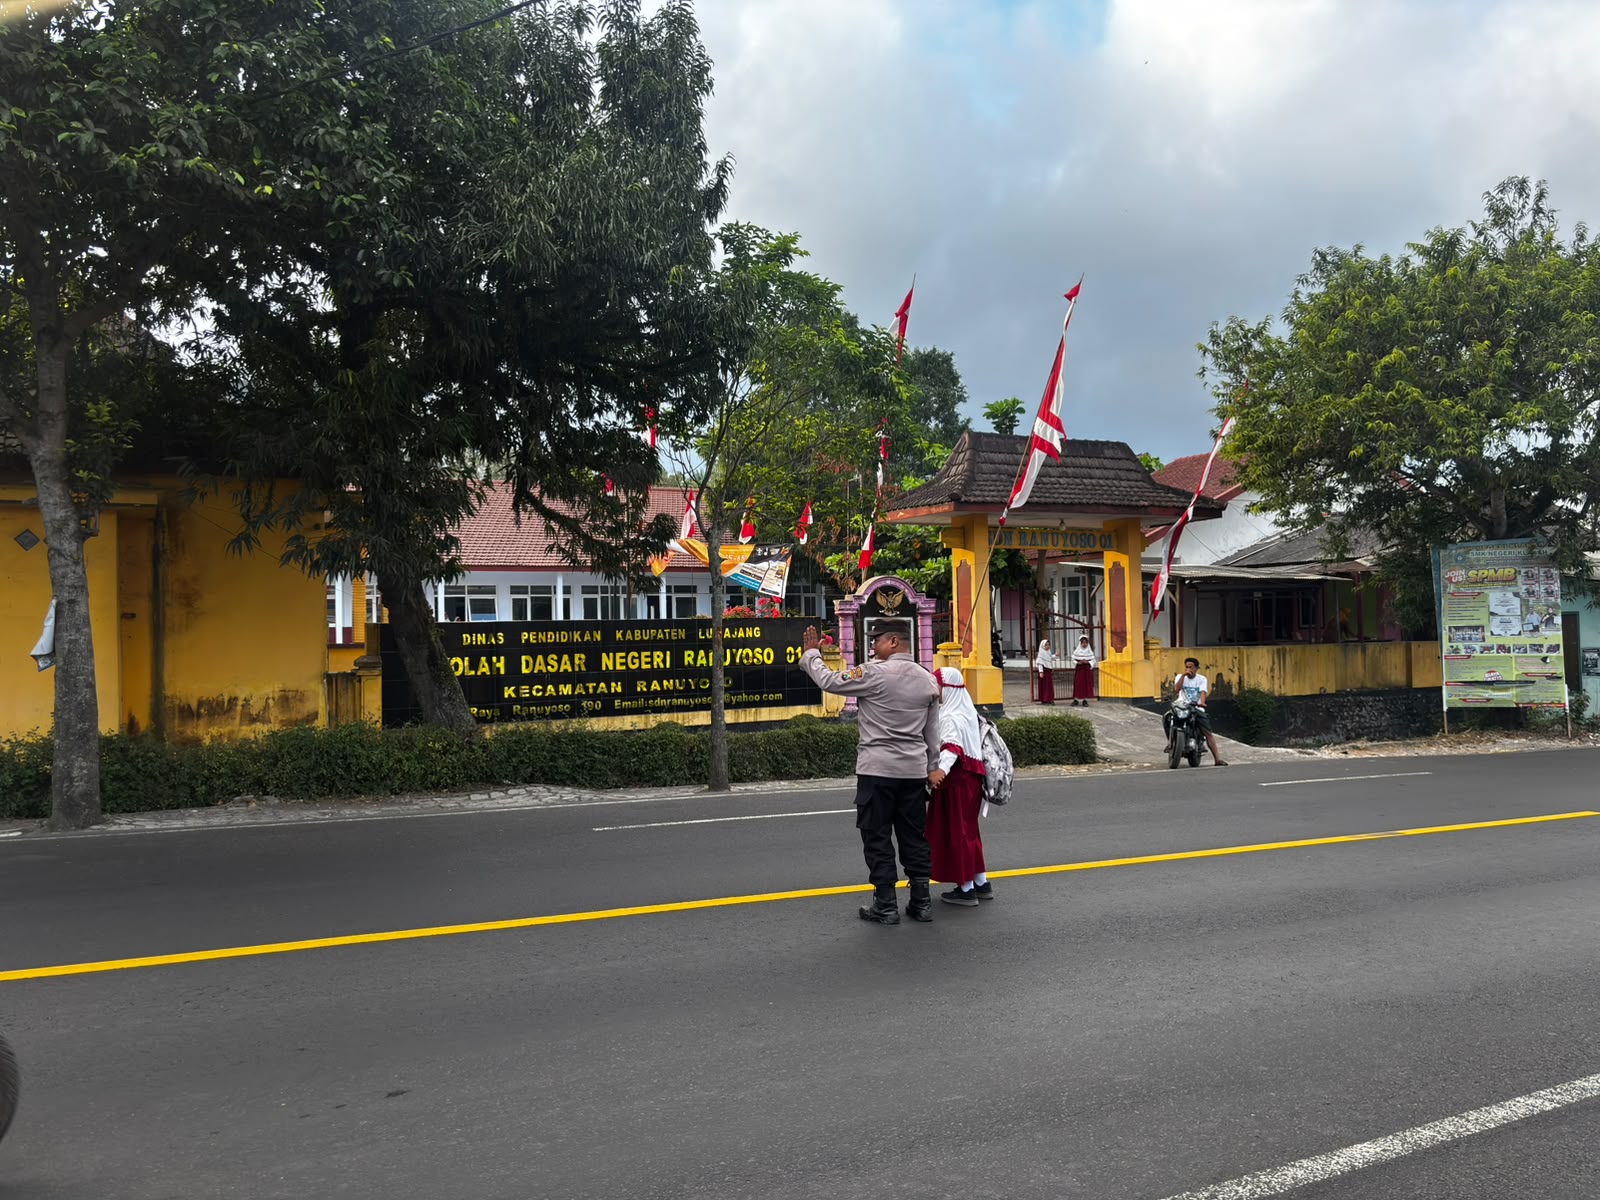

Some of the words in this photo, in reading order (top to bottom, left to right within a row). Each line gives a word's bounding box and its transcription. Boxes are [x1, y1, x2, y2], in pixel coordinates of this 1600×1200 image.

[1019, 531, 1097, 548] RANUYOSO
[1099, 533, 1114, 549] 01
[1445, 569, 1465, 578] JOIN
[1467, 567, 1516, 583] SPMB
[462, 632, 505, 646] DINAS
[521, 630, 601, 643] PENDIDIKAN
[615, 628, 686, 641] KABUPATEN
[698, 626, 761, 639] LUAJANG
[448, 655, 505, 676] OLAH
[521, 653, 587, 674] DASAR
[601, 650, 671, 671] NEGERI
[503, 681, 622, 699] KECAMATAN
[636, 676, 733, 692] RANUYOO
[470, 706, 501, 719] Raya
[513, 703, 572, 716] Ranuyoso
